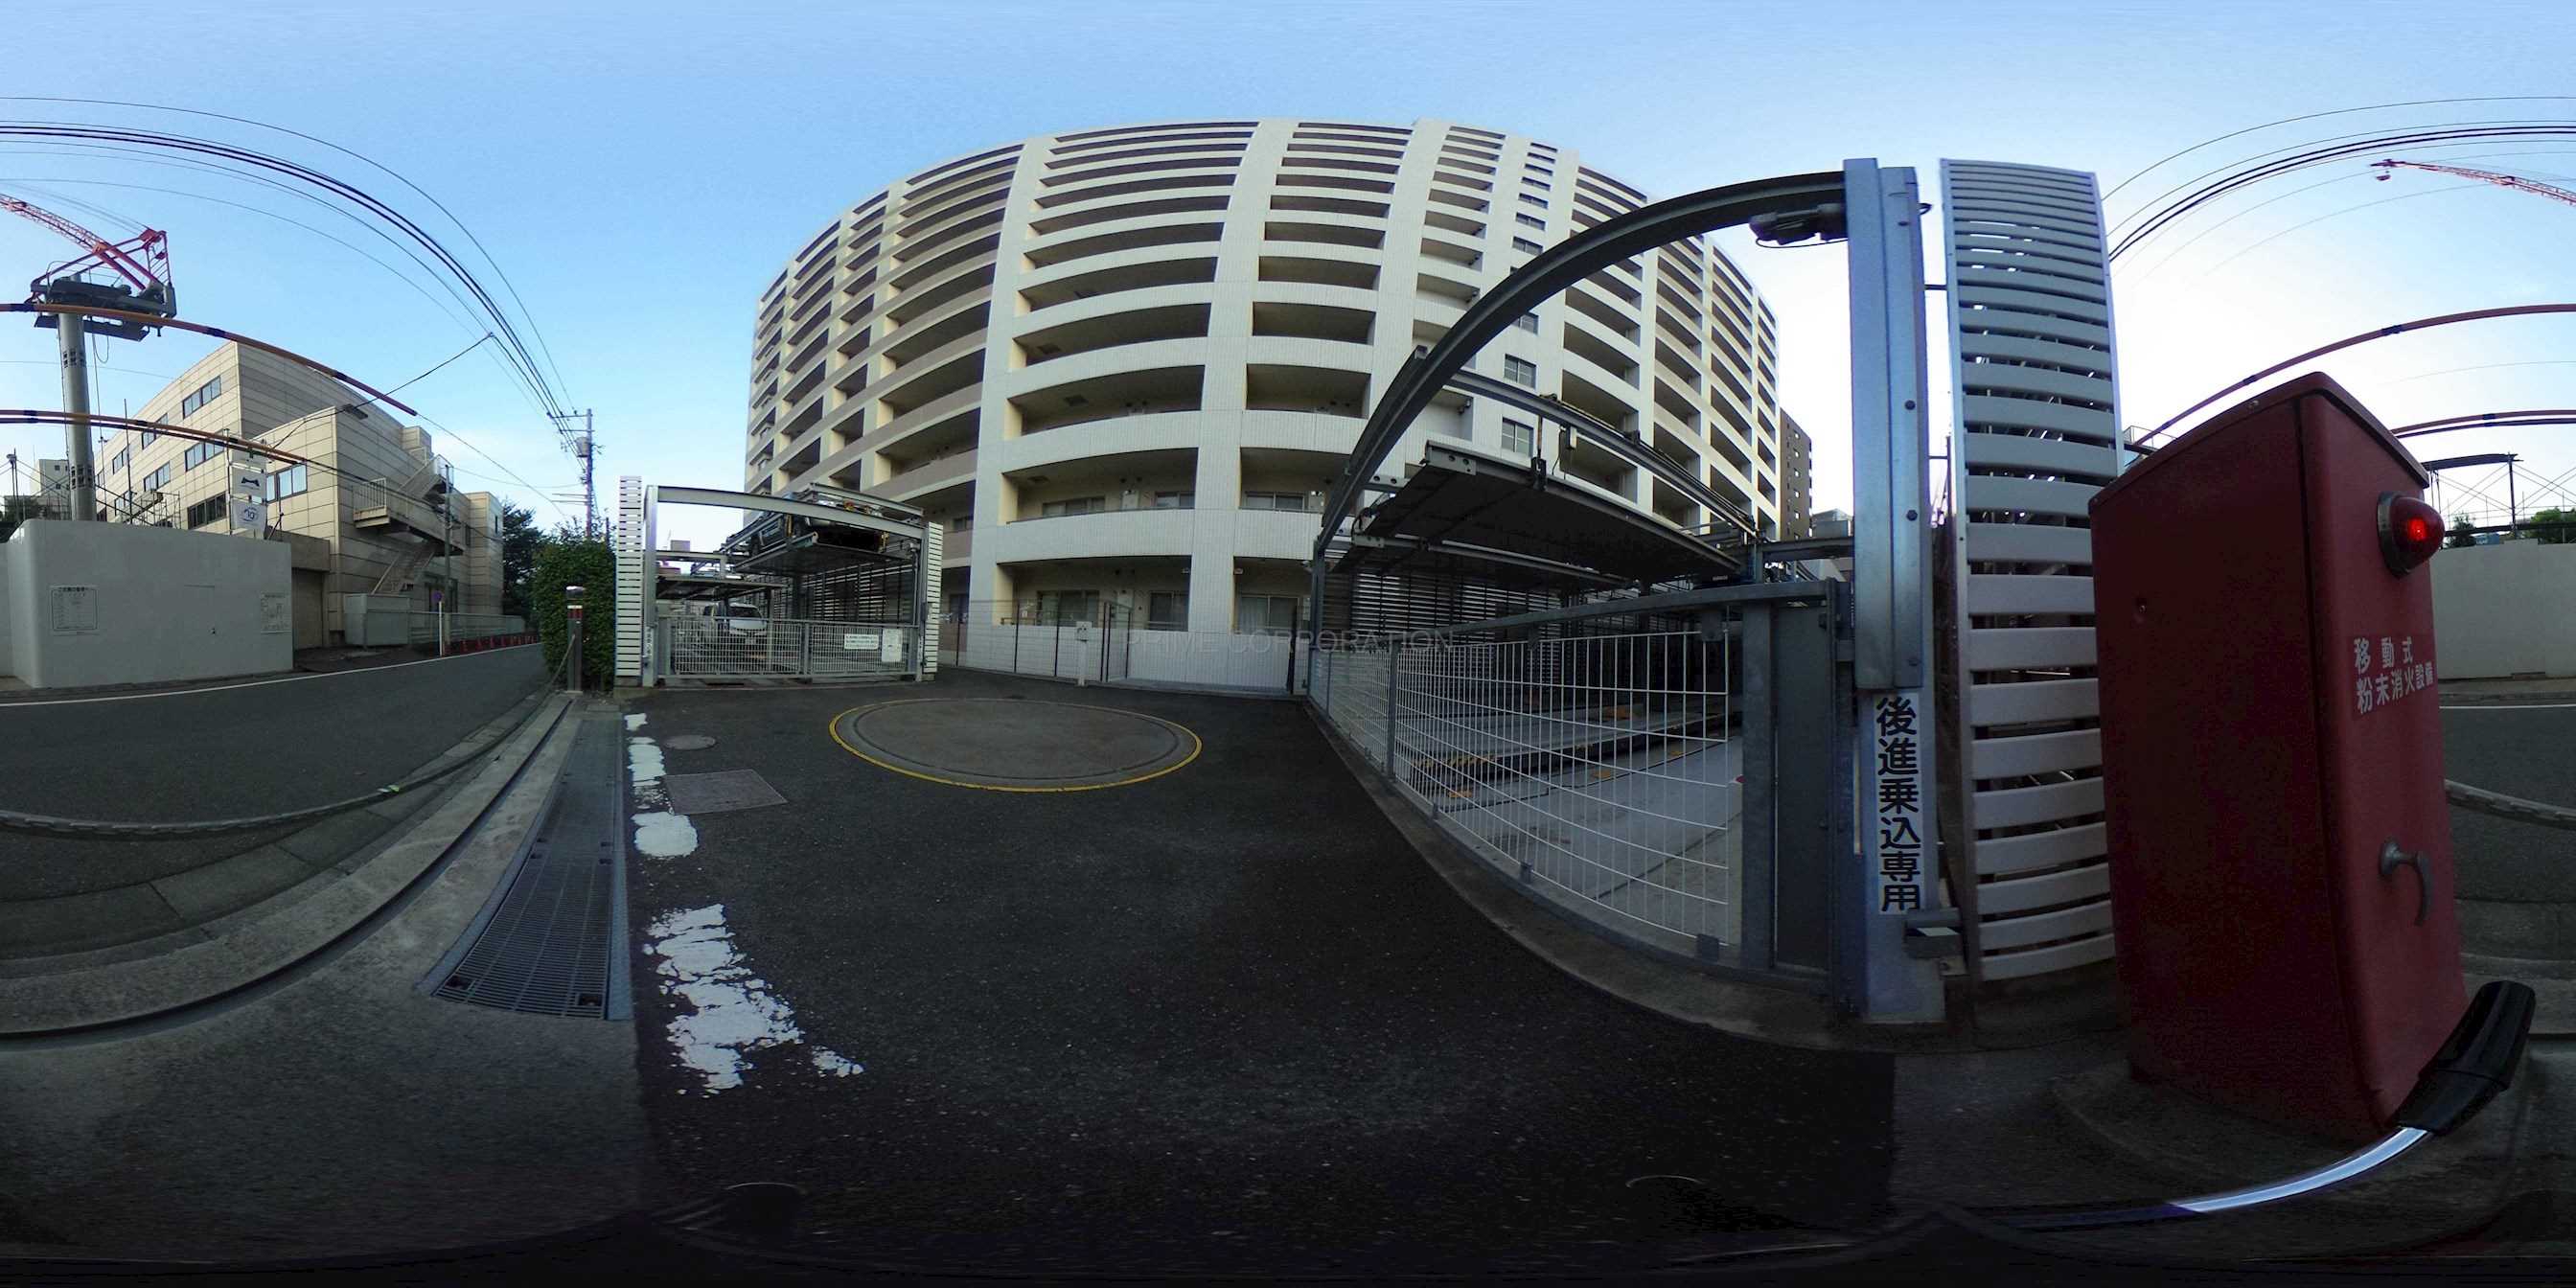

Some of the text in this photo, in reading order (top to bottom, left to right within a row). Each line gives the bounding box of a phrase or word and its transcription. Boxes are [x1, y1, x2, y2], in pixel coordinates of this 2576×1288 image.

[2355, 636, 2413, 674] 移動式
[2357, 662, 2433, 714] 粉末消火設備
[1875, 696, 1921, 912] 後進乗込専用
